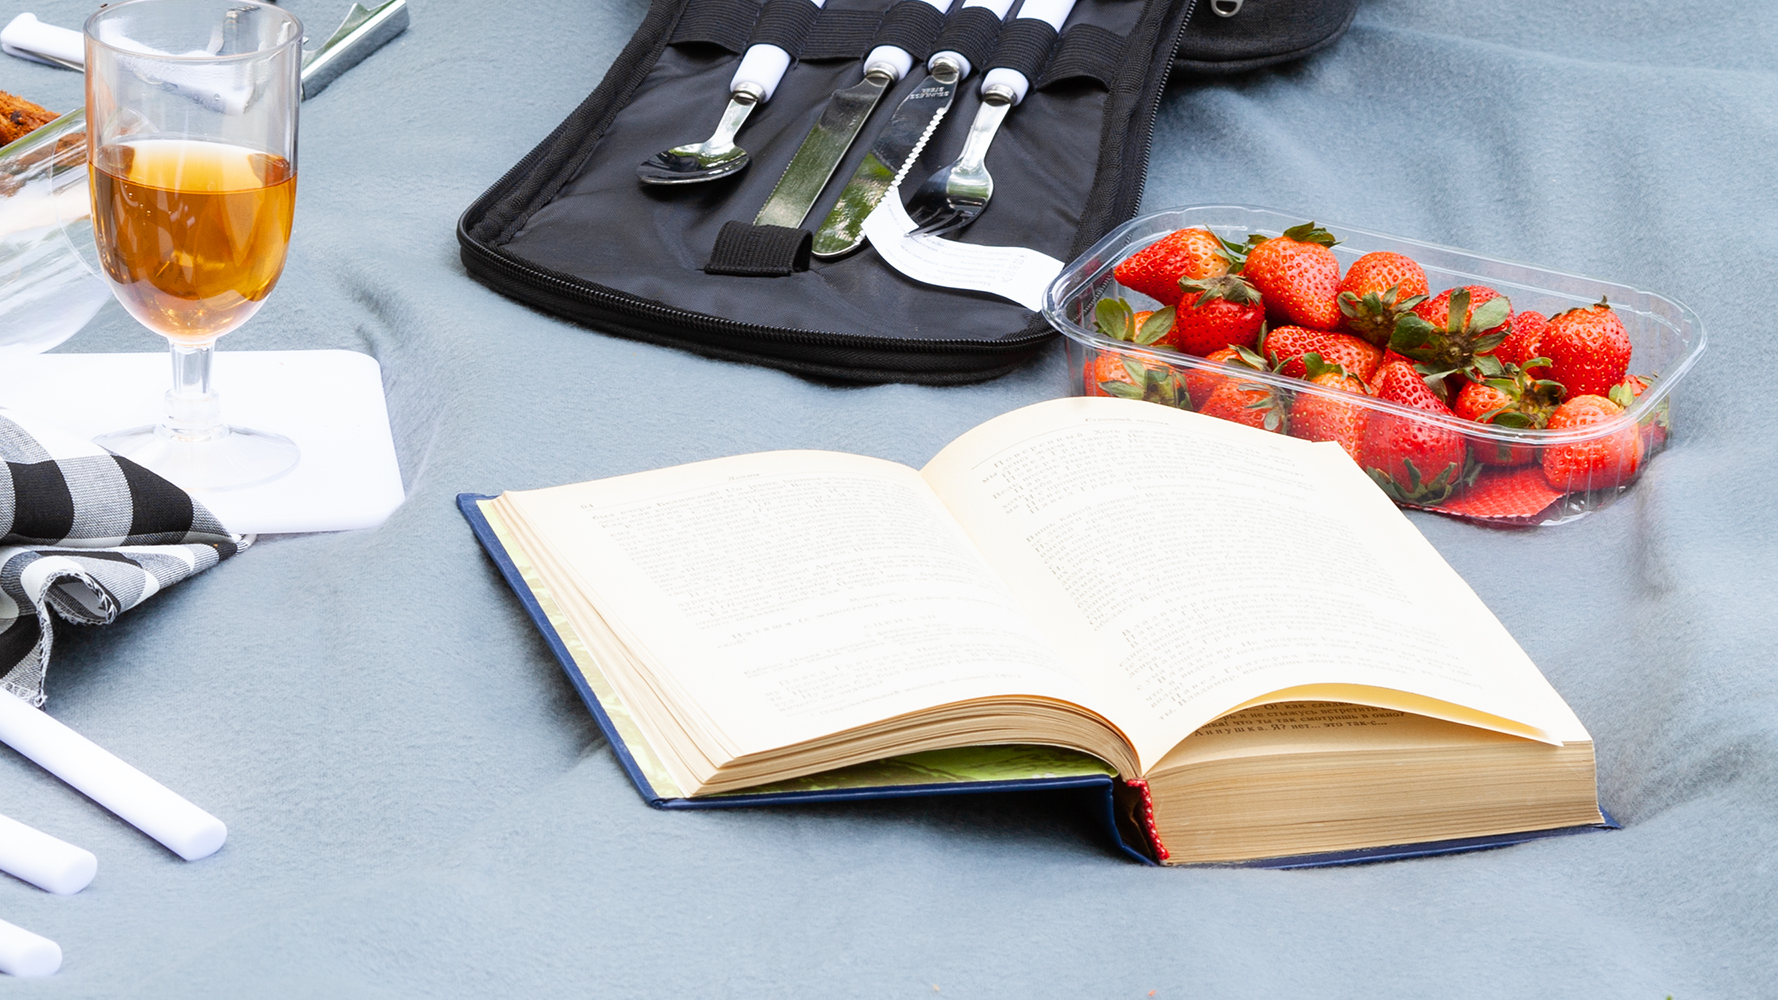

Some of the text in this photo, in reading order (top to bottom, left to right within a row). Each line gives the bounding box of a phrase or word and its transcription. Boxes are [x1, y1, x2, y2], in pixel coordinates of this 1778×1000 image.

[909, 90, 950, 100] STAINLESS
[1285, 702, 1306, 710] как
[1267, 709, 1318, 718] стыжусь
[1321, 707, 1378, 715] встретить
[1233, 719, 1253, 727] что
[1300, 714, 1358, 722] смотришь
[1270, 723, 1286, 731] Я?
